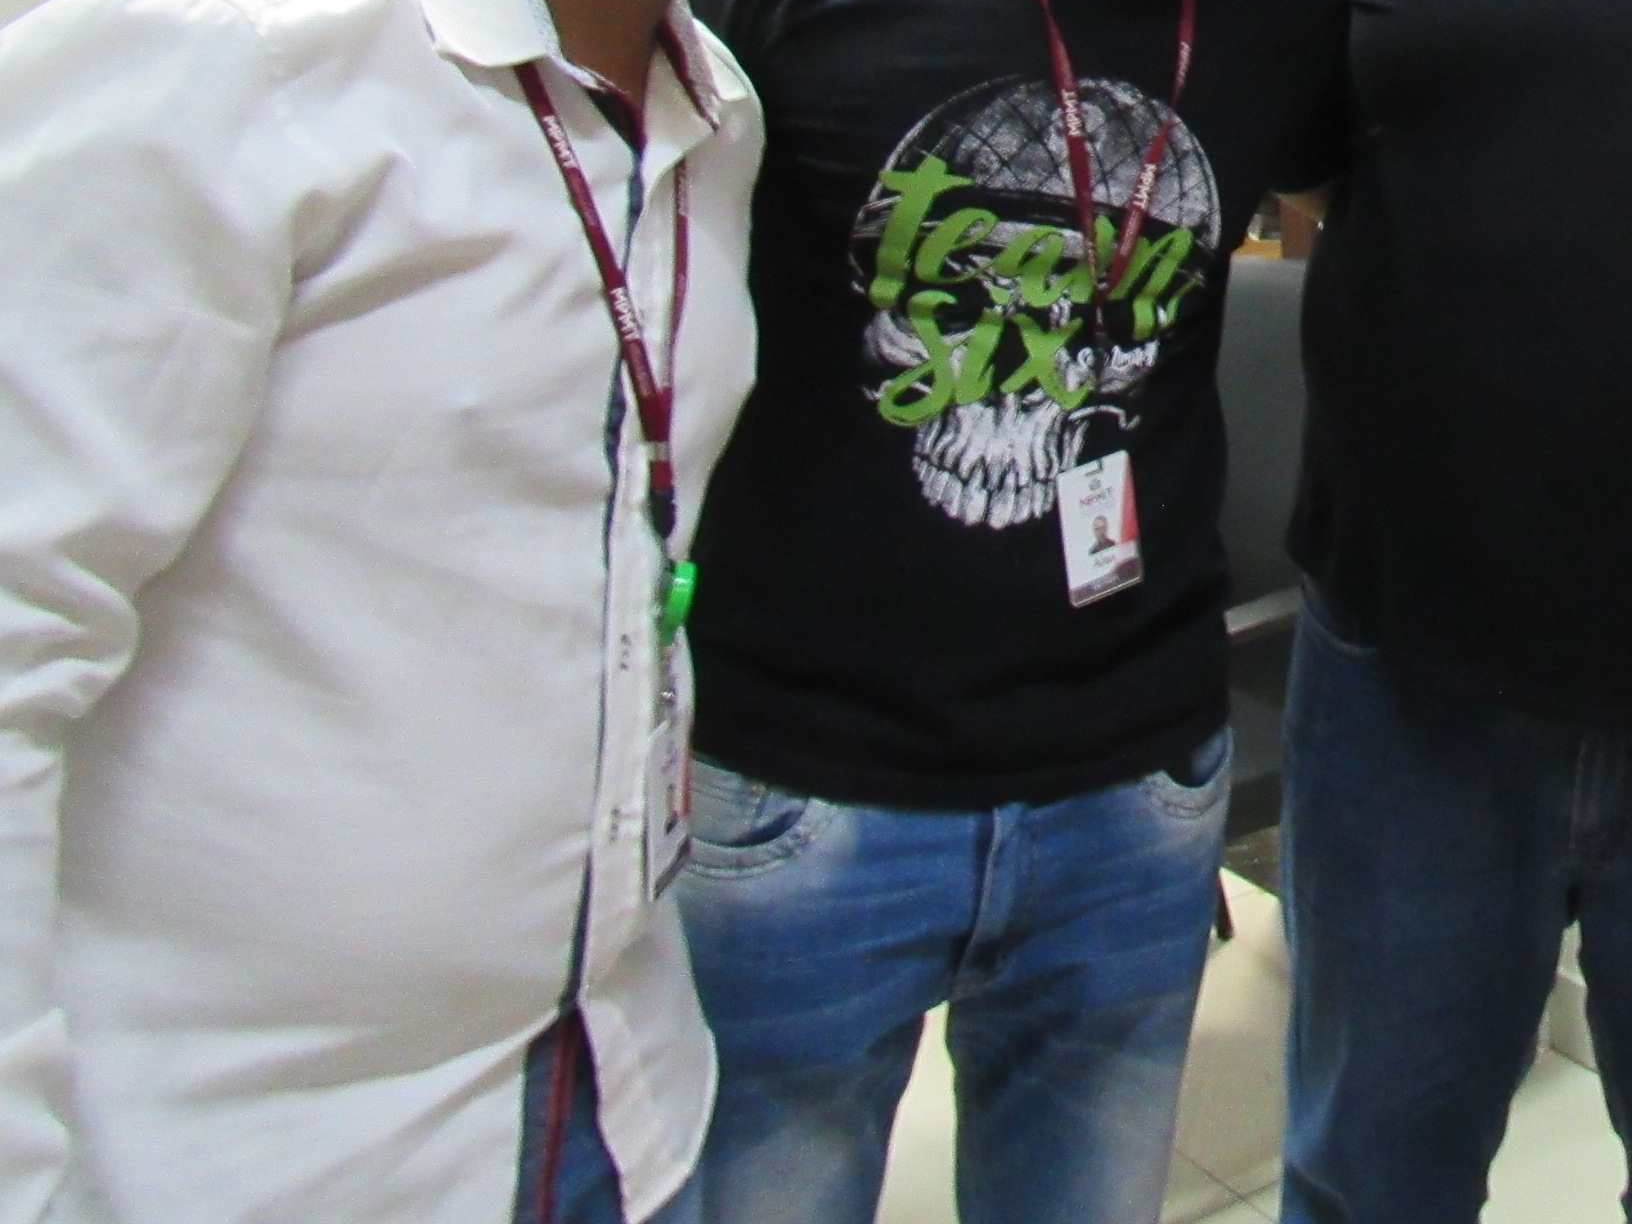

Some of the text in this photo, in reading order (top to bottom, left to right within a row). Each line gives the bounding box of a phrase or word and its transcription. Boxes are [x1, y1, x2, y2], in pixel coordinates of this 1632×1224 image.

[1061, 88, 1081, 136] MPMT
[1132, 163, 1157, 209] MPMT
[611, 287, 640, 340] MPMT
